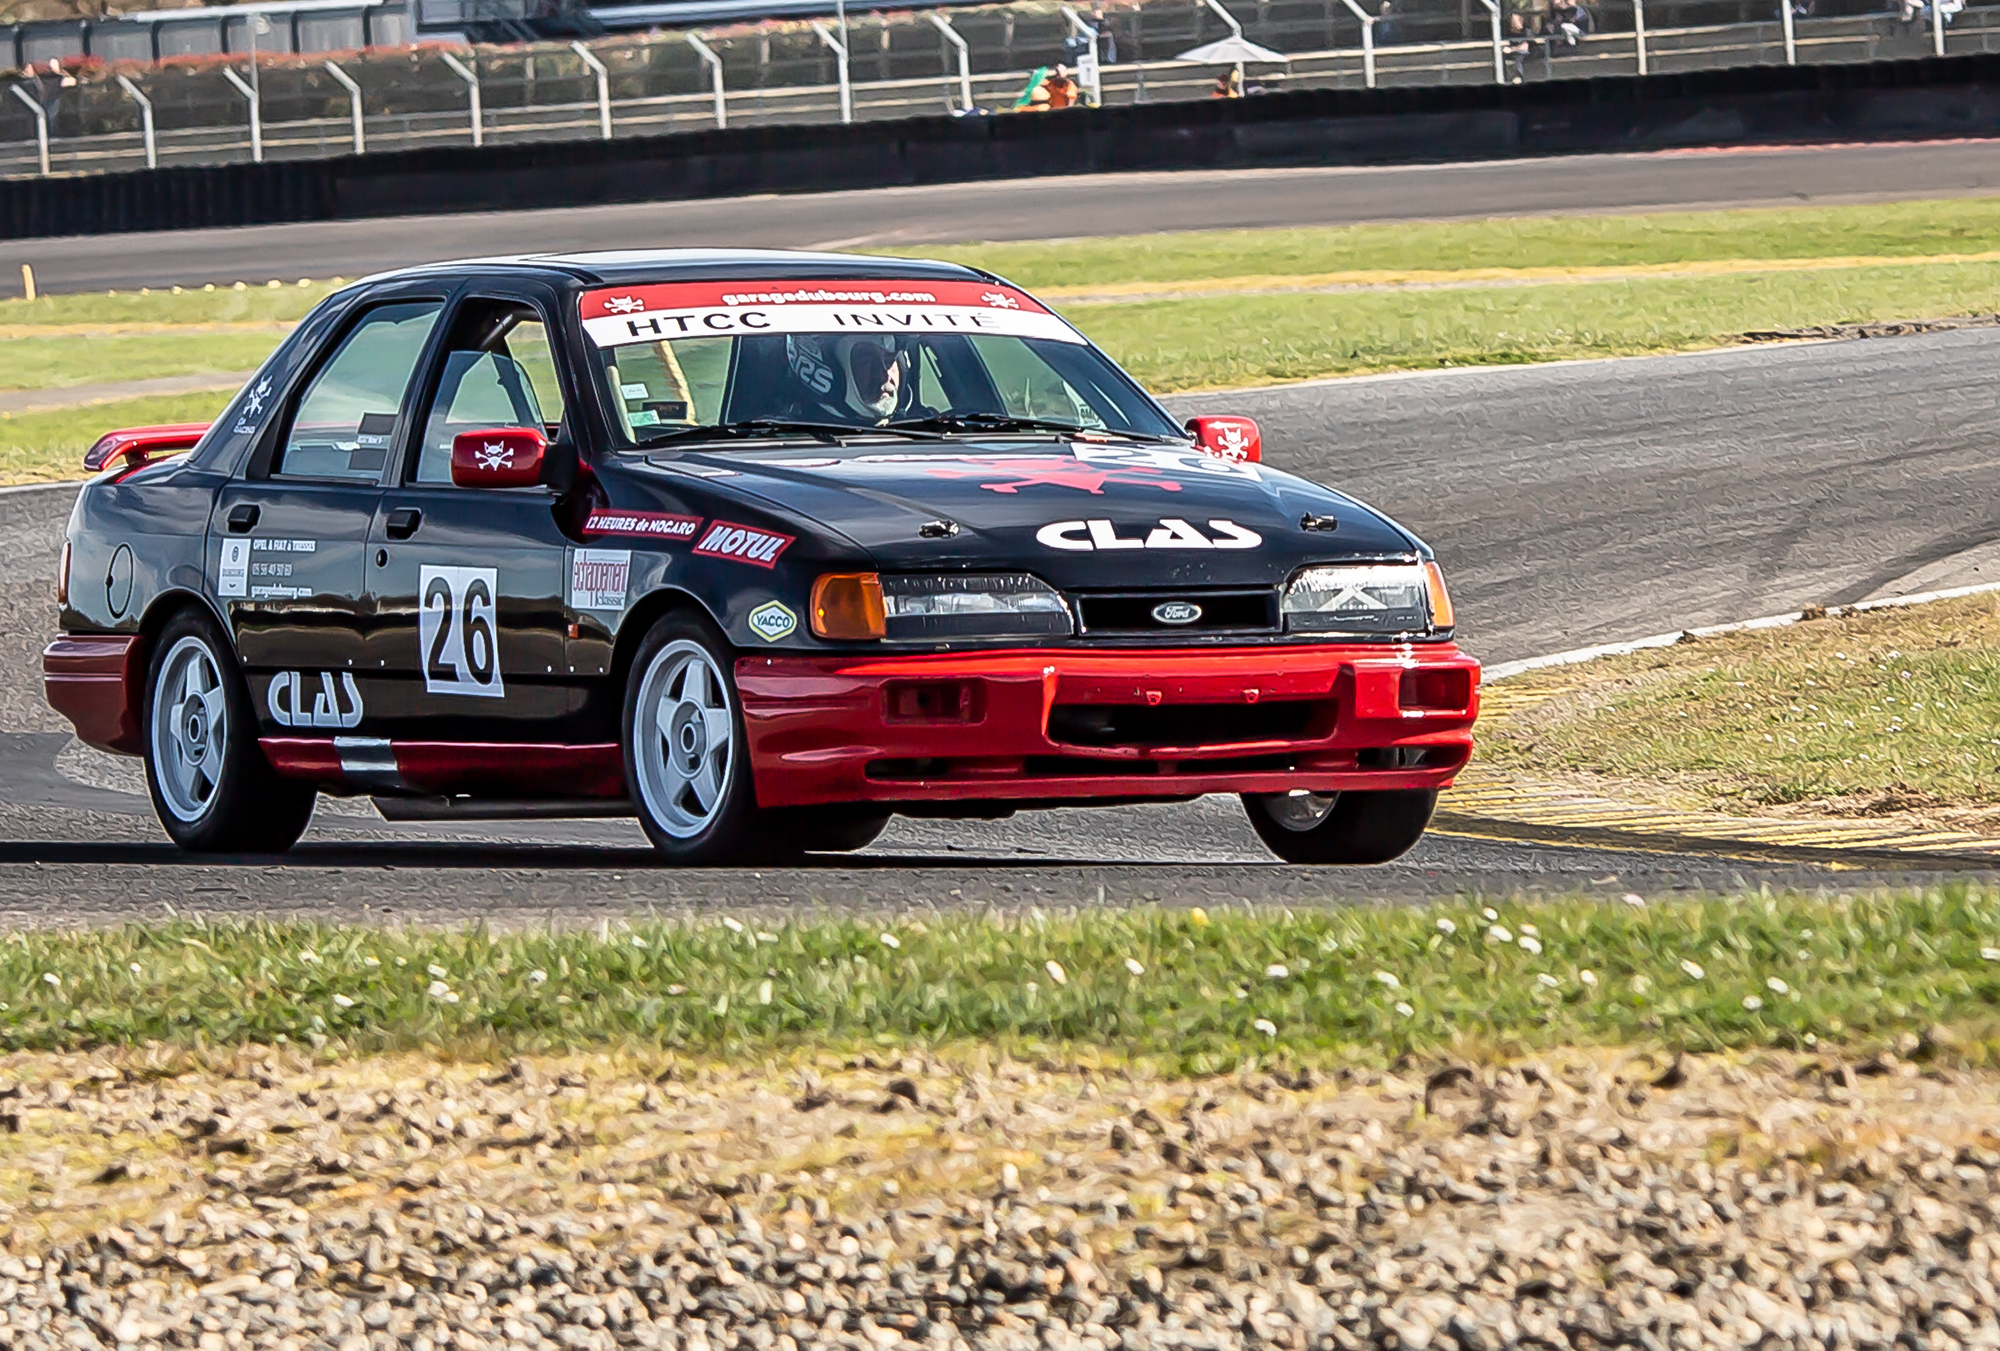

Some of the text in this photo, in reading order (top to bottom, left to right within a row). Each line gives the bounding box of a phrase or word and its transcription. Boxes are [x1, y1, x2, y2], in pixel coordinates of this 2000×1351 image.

[722, 289, 935, 306] garagedubourg.com
[626, 311, 1000, 337] HTCC INVITÉ
[585, 516, 696, 535] 12 HEURES de NOGARO
[1036, 519, 1263, 550] CLAS
[698, 525, 786, 562] MOTUL
[757, 614, 790, 629] YACCO
[1164, 605, 1190, 619] Ford
[424, 576, 495, 686] 26
[268, 671, 364, 728] CLAS
